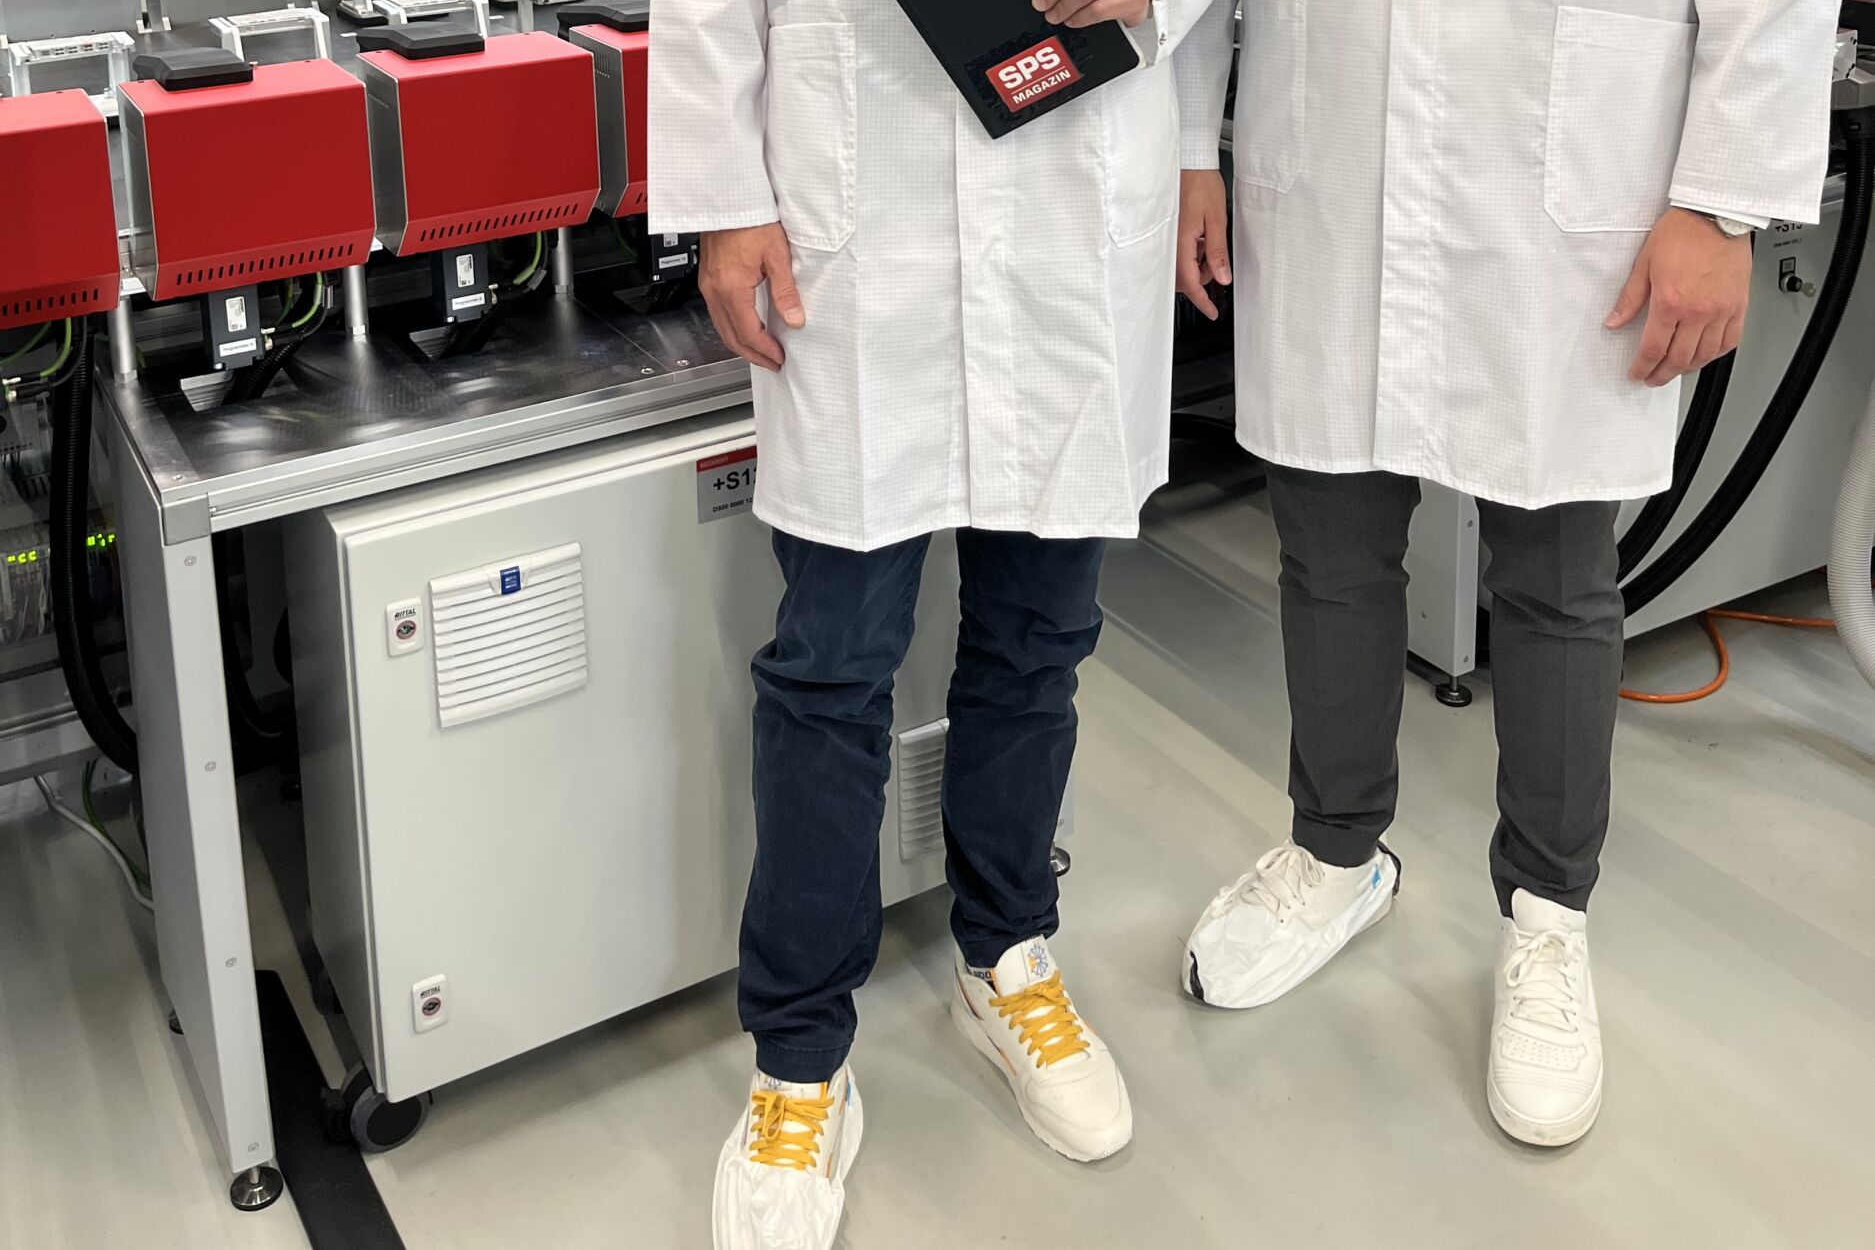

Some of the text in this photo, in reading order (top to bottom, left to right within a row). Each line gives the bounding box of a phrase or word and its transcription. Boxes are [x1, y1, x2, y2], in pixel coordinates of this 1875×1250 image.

[998, 46, 1061, 89] SPS
[1012, 69, 1071, 104] MAGAZIN
[712, 466, 757, 491] +S1
